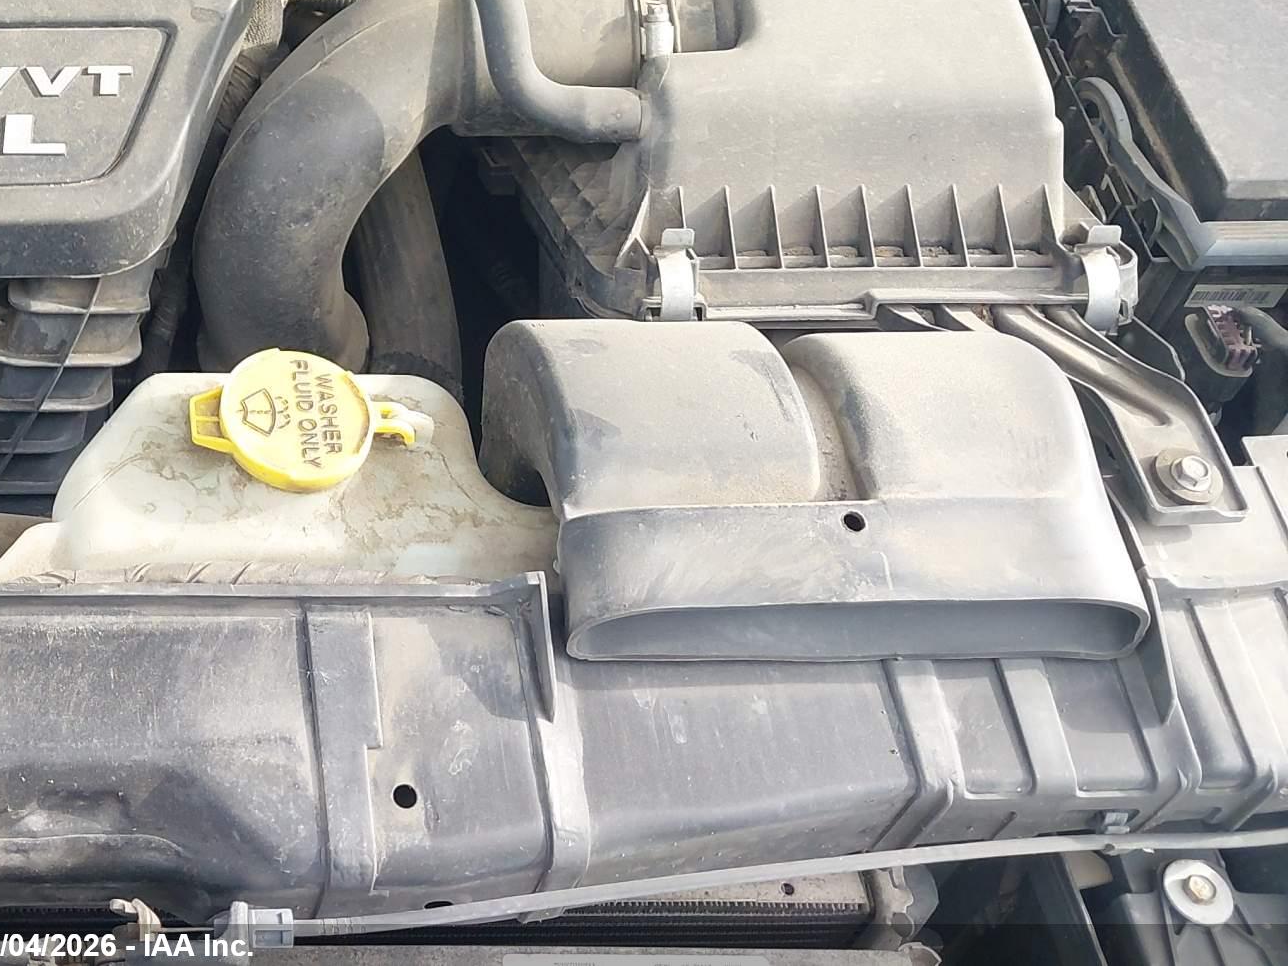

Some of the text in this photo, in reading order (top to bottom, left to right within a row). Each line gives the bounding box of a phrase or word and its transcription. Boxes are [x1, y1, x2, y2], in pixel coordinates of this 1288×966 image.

[290, 359, 322, 468] FLUID ONLY
[315, 374, 343, 453] WASHER
